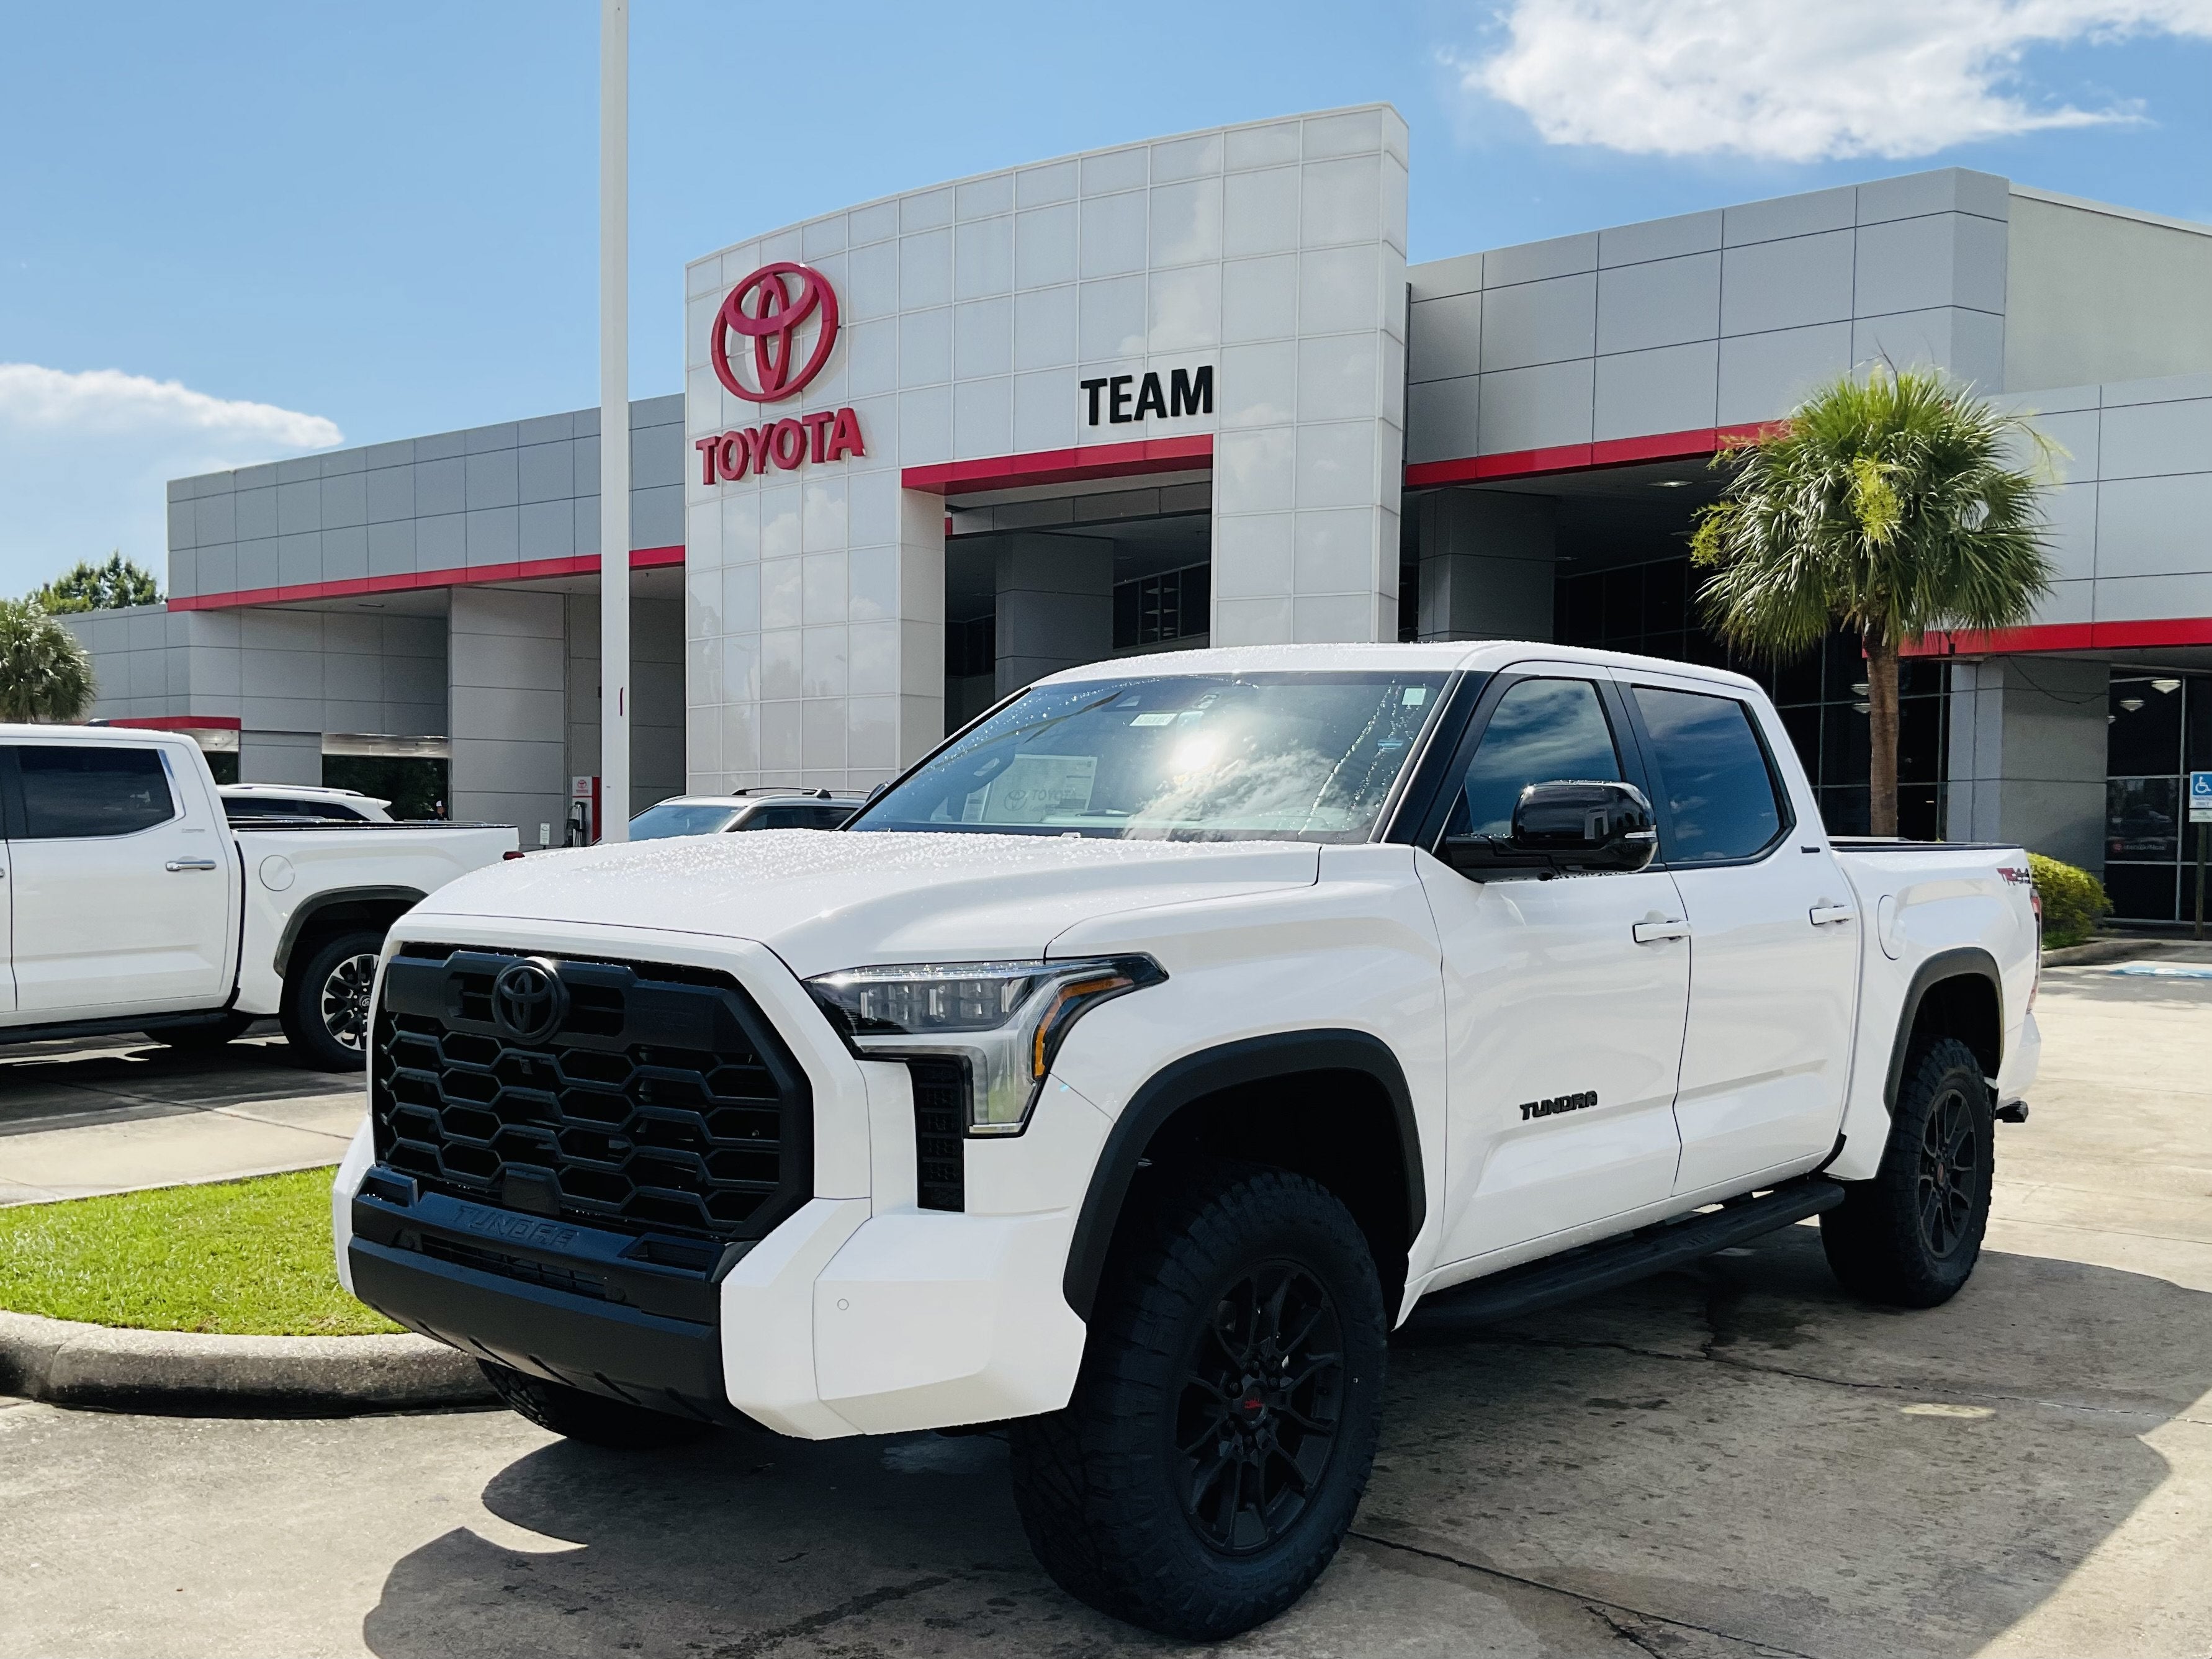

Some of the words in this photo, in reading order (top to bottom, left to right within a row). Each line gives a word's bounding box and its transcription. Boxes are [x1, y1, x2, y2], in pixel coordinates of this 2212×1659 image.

[1081, 366, 1213, 425] TEAM
[696, 407, 865, 485] TOYOTA
[1519, 1090, 1598, 1120] TUNDRA
[452, 1205, 580, 1248] TUNDRA
